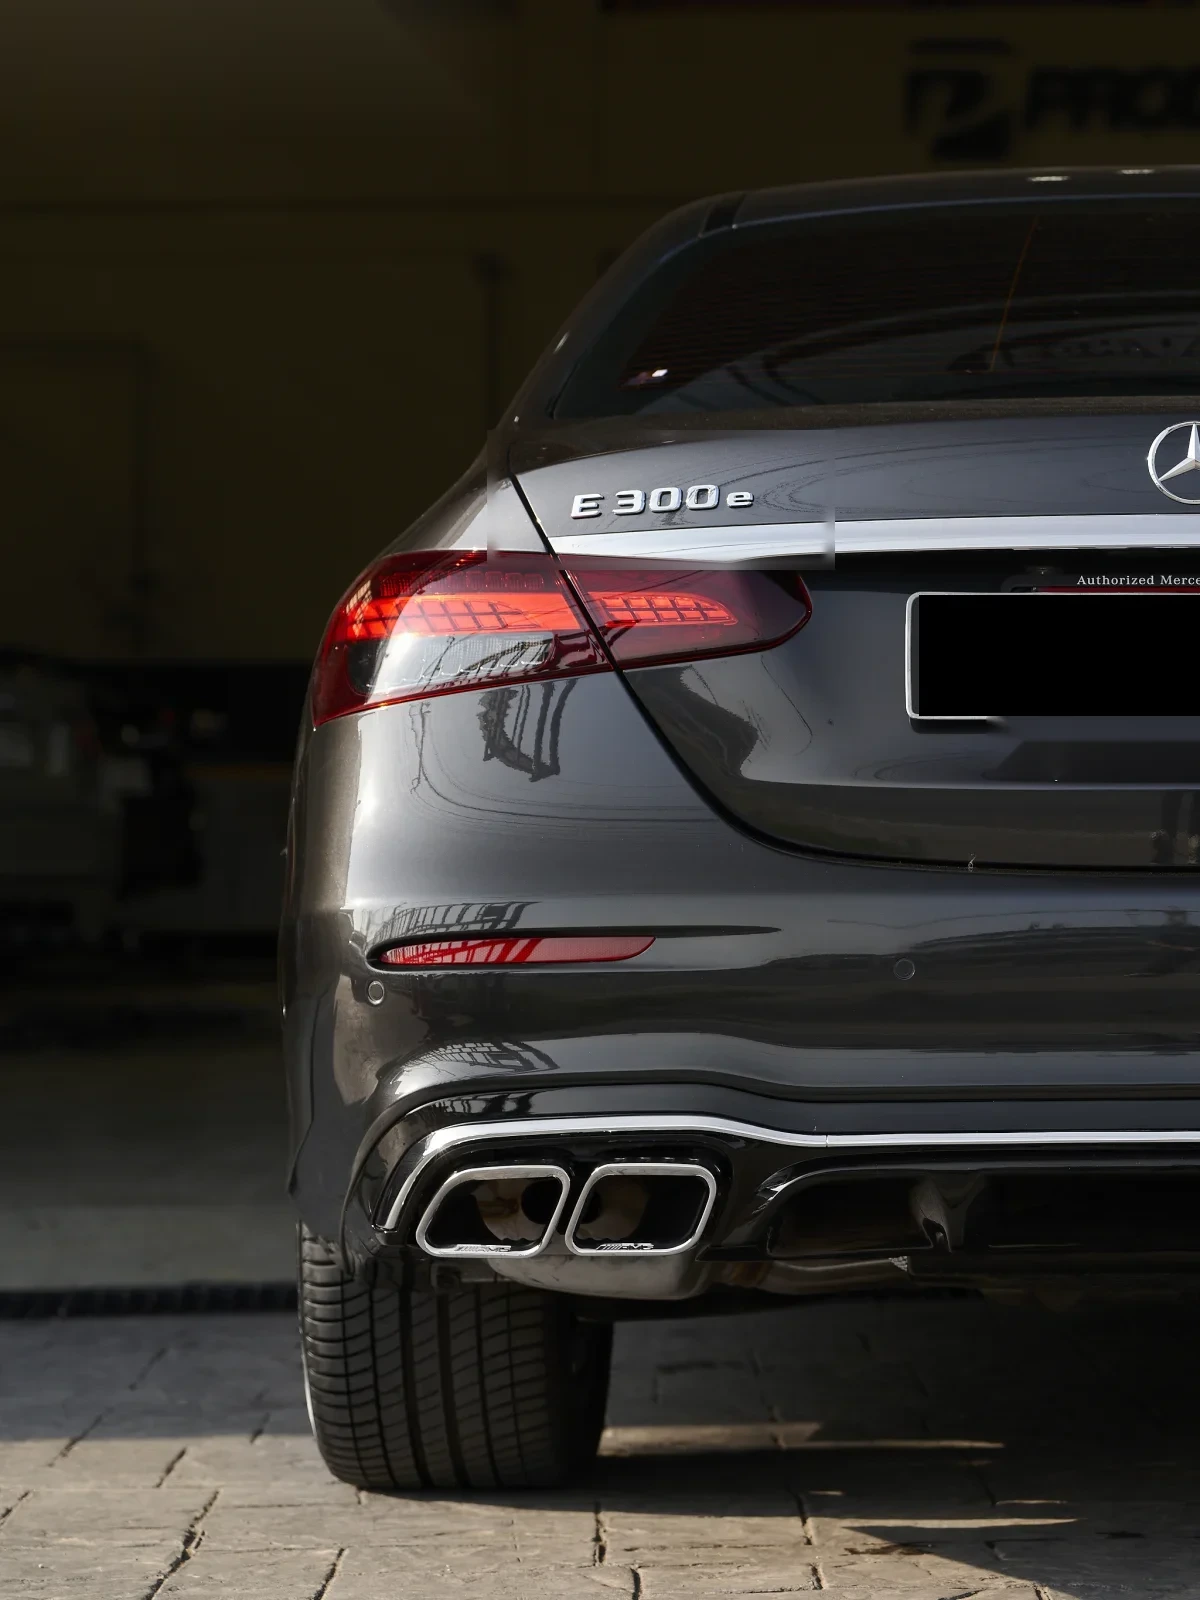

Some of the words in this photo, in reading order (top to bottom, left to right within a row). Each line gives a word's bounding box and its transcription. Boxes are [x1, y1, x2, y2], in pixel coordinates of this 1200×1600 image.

[570, 493, 604, 519] E
[612, 484, 720, 515] 300
[726, 491, 754, 508] e
[1076, 575, 1155, 585] Authorized
